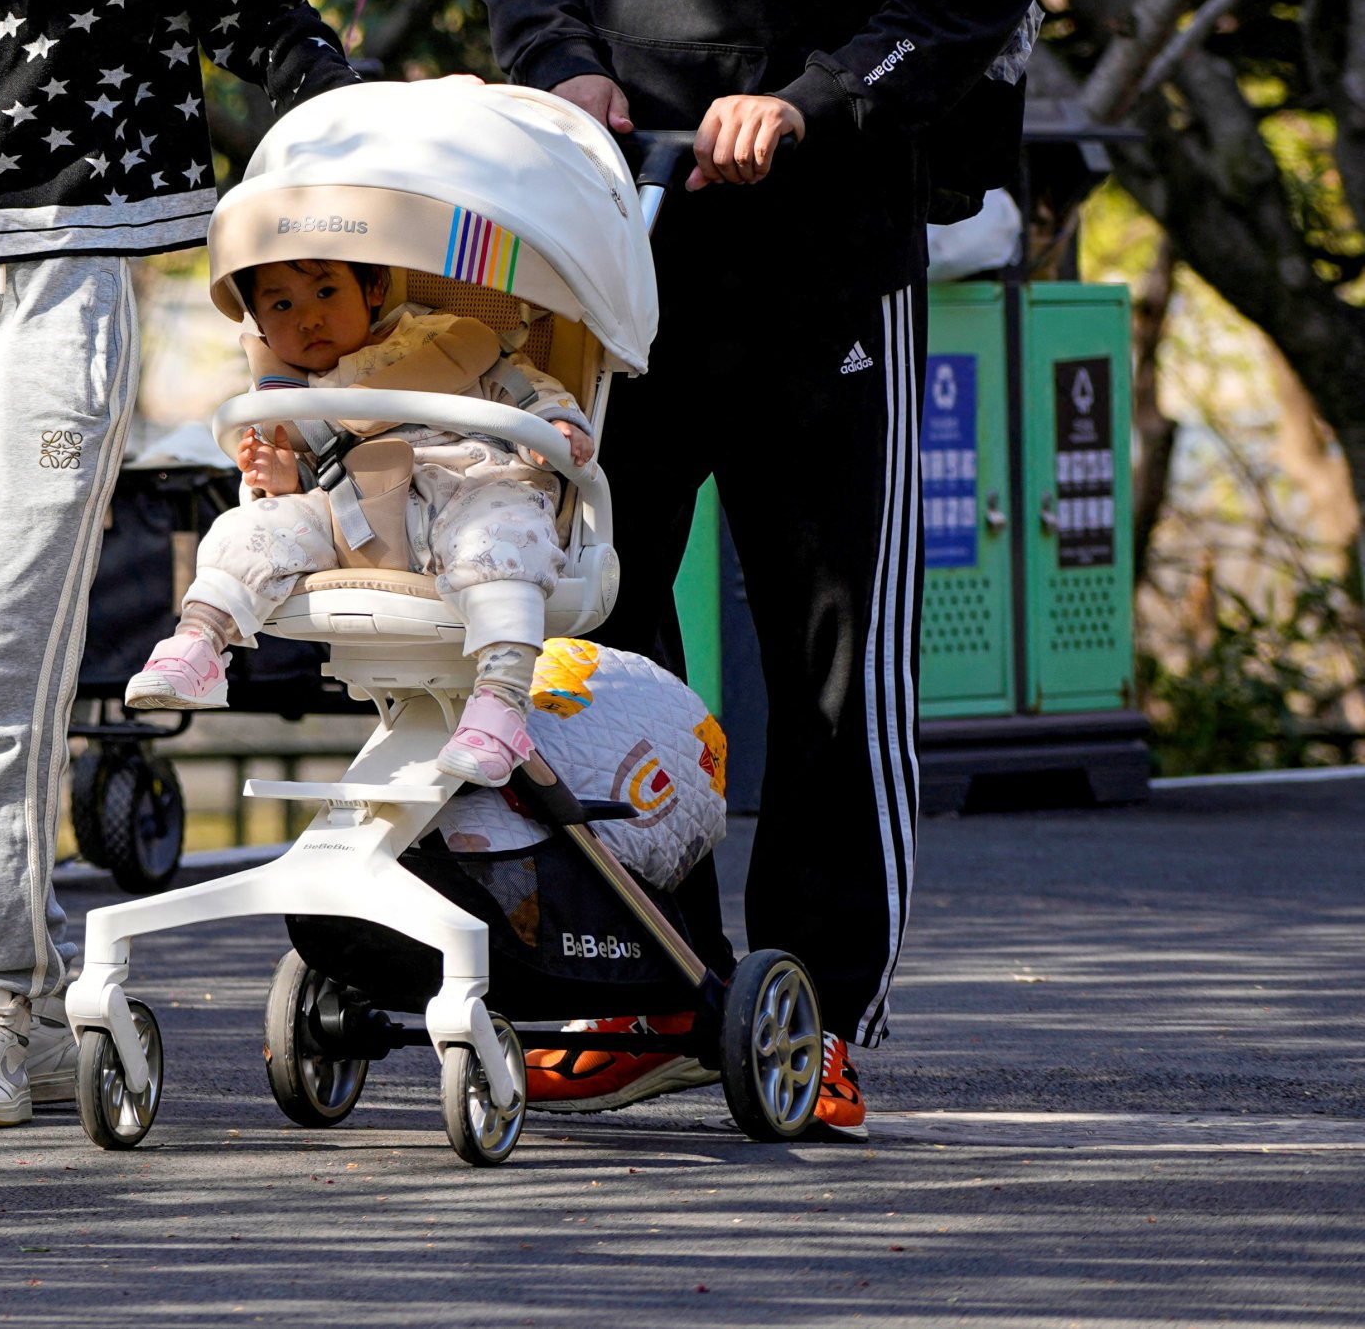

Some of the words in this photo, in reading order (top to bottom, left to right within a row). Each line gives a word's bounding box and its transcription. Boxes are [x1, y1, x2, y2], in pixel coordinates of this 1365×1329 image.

[277, 215, 369, 235] BeBeBus
[840, 356, 874, 375] adidas
[562, 932, 641, 959] BeBeBus
